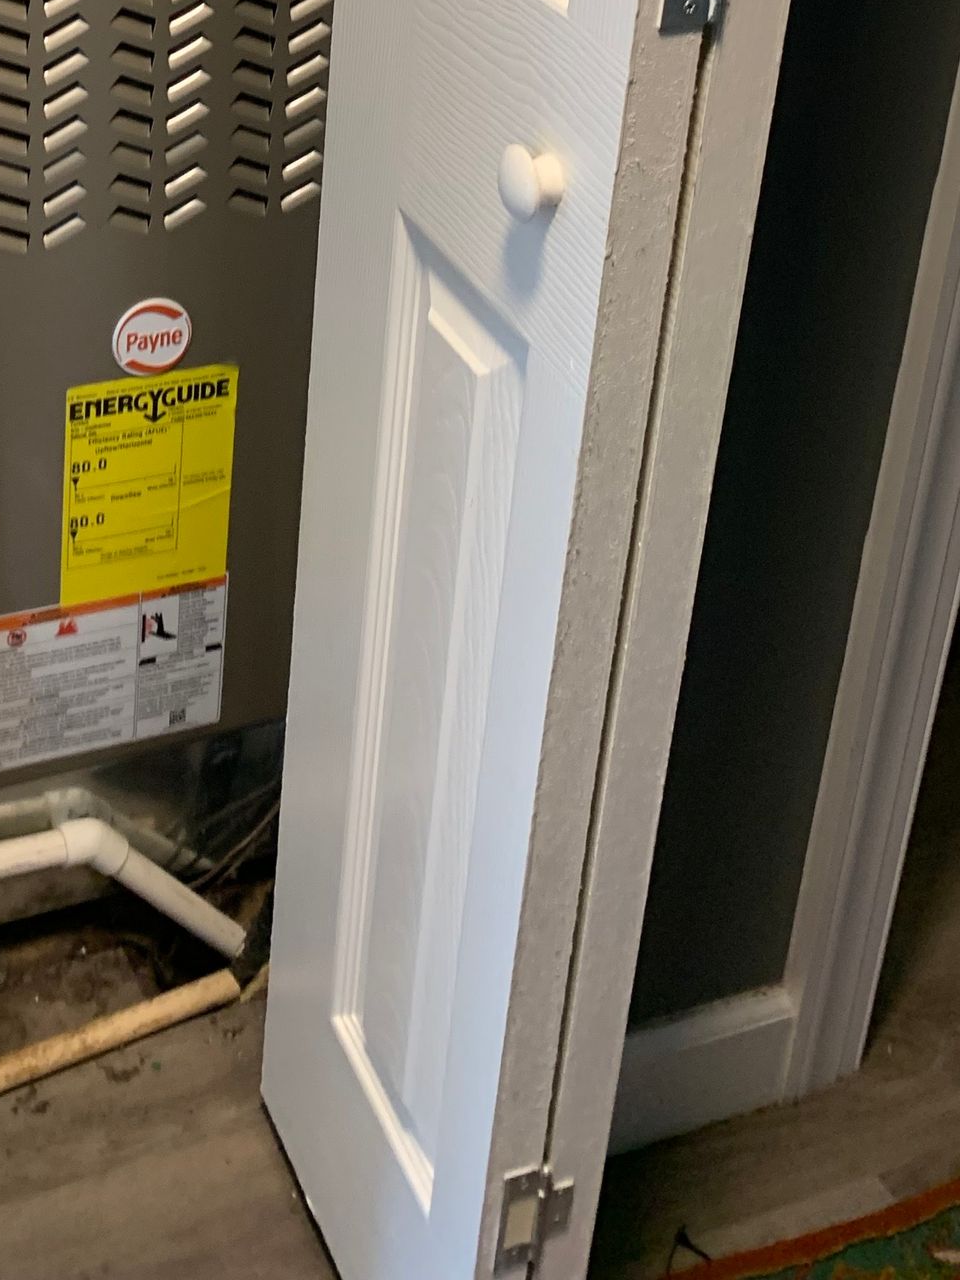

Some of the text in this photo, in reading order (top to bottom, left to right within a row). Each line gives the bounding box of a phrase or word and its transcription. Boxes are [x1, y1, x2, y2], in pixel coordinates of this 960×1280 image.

[126, 328, 183, 354] Payne
[69, 378, 230, 424] ENERGYGUIDE
[71, 457, 108, 475] 80.0
[70, 511, 105, 529] 80.0
